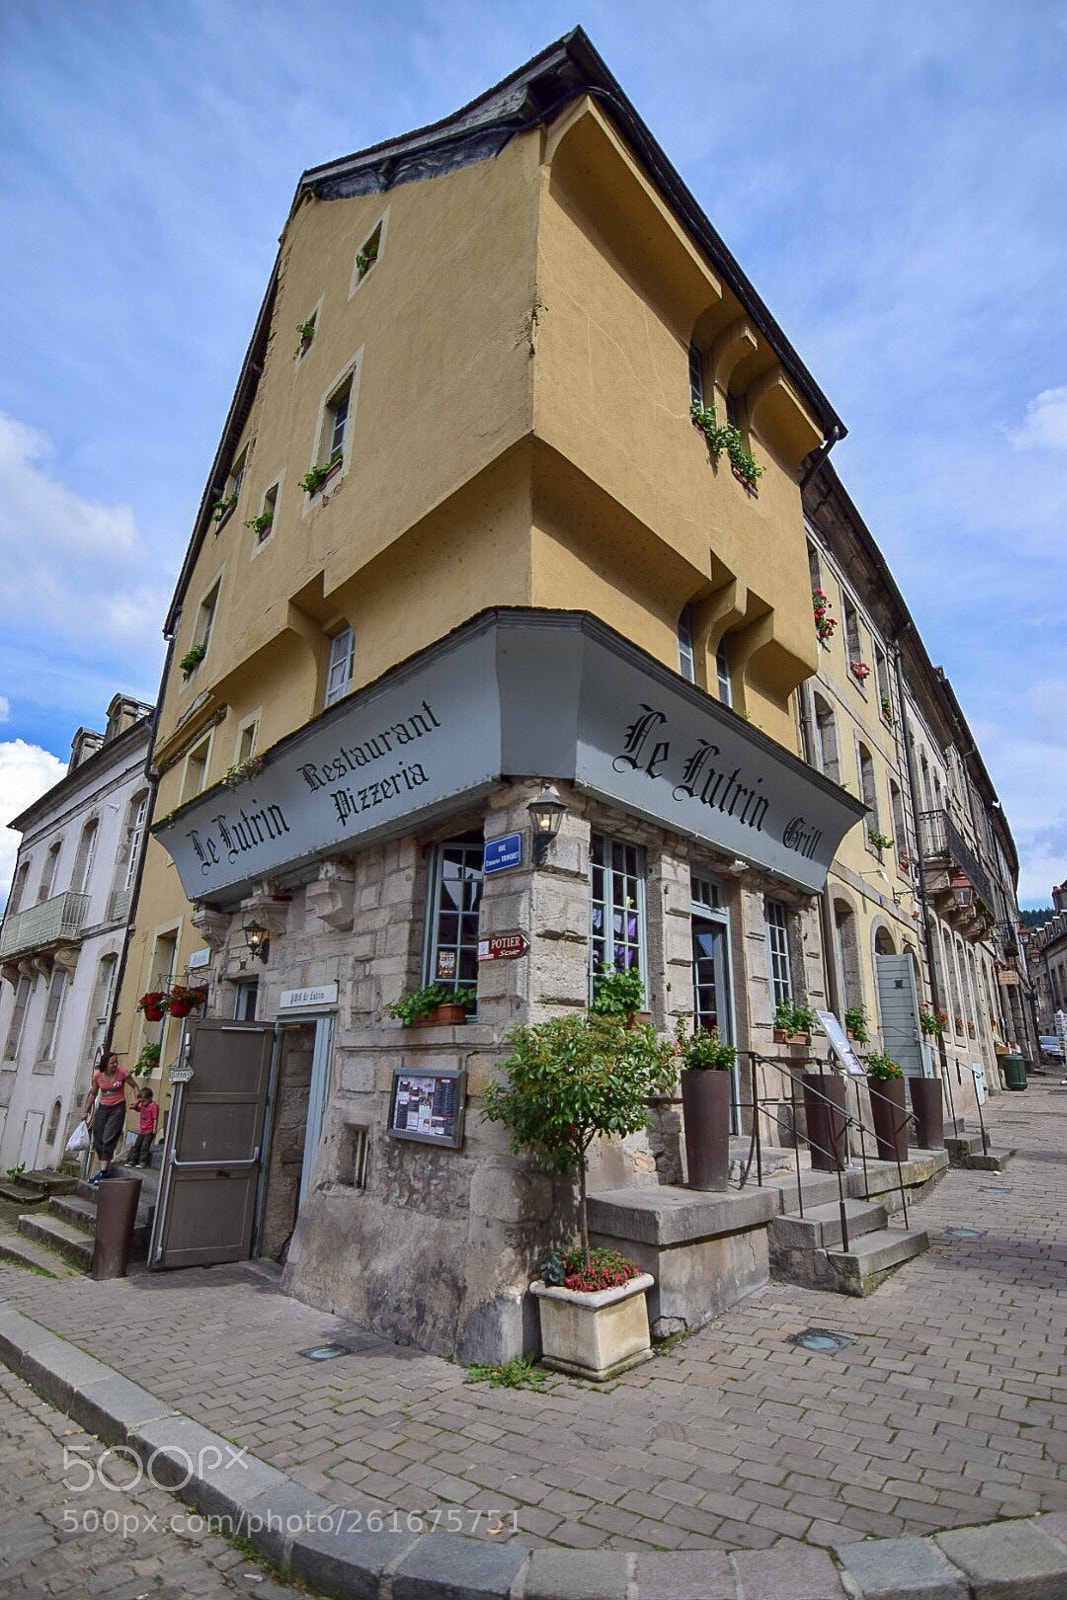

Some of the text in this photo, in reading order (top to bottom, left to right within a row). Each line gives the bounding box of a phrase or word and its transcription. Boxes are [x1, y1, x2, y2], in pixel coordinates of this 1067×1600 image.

[296, 700, 442, 793] Restaurant
[612, 703, 770, 832] Le Lutrin
[330, 761, 430, 826] Pizzeria
[186, 799, 290, 875] Le Lutrin
[782, 816, 824, 860] Grill
[491, 936, 521, 949] POTIER
